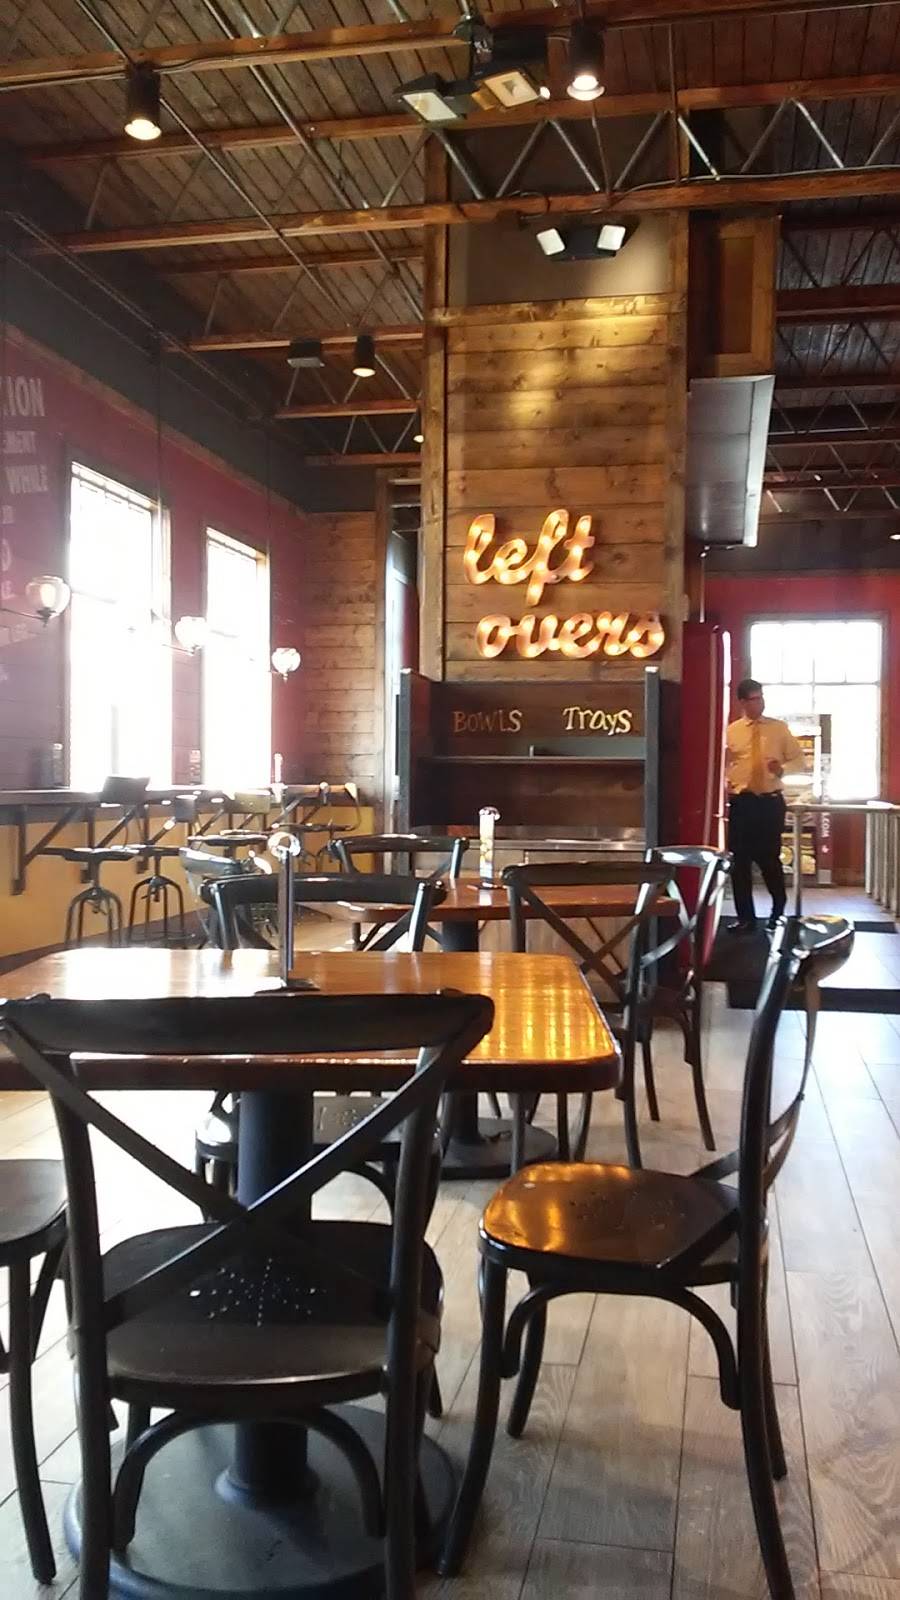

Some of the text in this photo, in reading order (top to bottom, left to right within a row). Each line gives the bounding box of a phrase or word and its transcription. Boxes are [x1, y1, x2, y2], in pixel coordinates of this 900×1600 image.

[464, 509, 595, 607] left
[477, 611, 665, 659] overs
[563, 706, 632, 736] Trays
